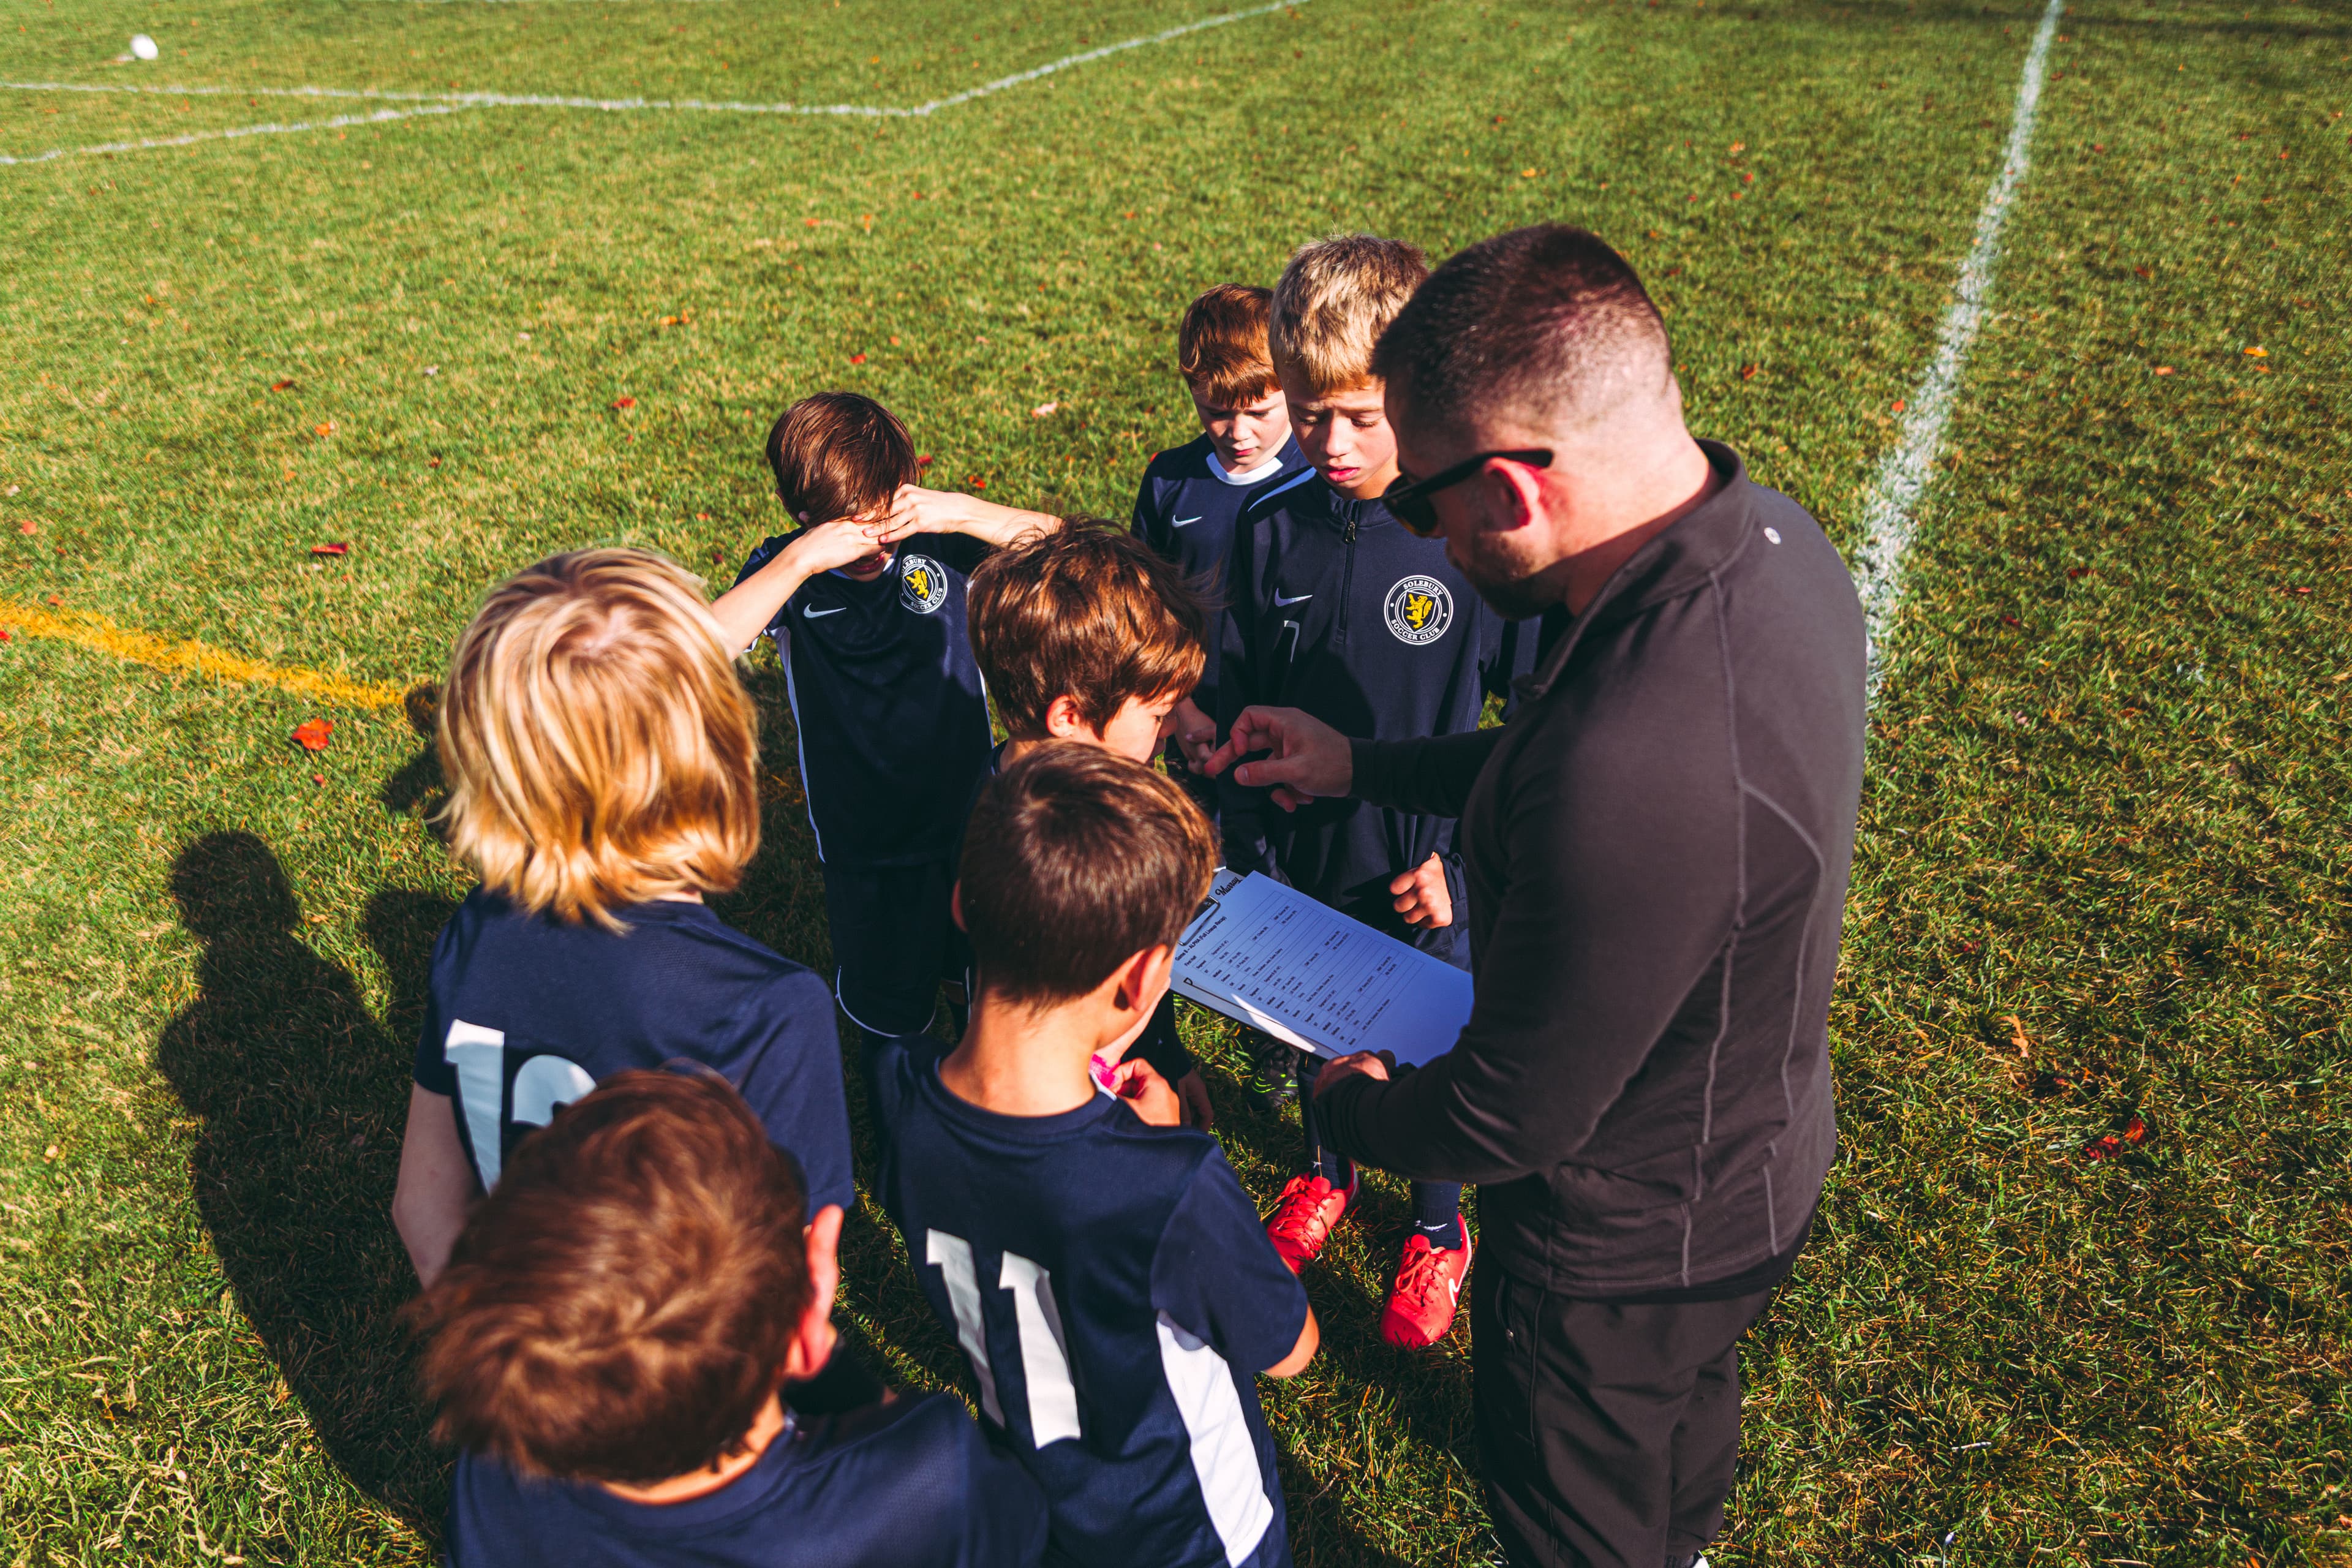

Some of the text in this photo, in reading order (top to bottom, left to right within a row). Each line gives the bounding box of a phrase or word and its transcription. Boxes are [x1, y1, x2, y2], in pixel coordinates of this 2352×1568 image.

[901, 558, 927, 575] OLEBURY
[911, 587, 943, 610] SOCCER CLUB
[1403, 580, 1444, 597] SOLEBURY
[1391, 619, 1440, 641] SOCCER CLUB
[1215, 876, 1243, 896] Murray
[1175, 952, 1186, 961] Game
[1188, 938, 1201, 949] ALPHA
[1204, 924, 1218, 935] Lineup
[1214, 916, 1227, 926] Recap)
[926, 1227, 1081, 1450] 11
